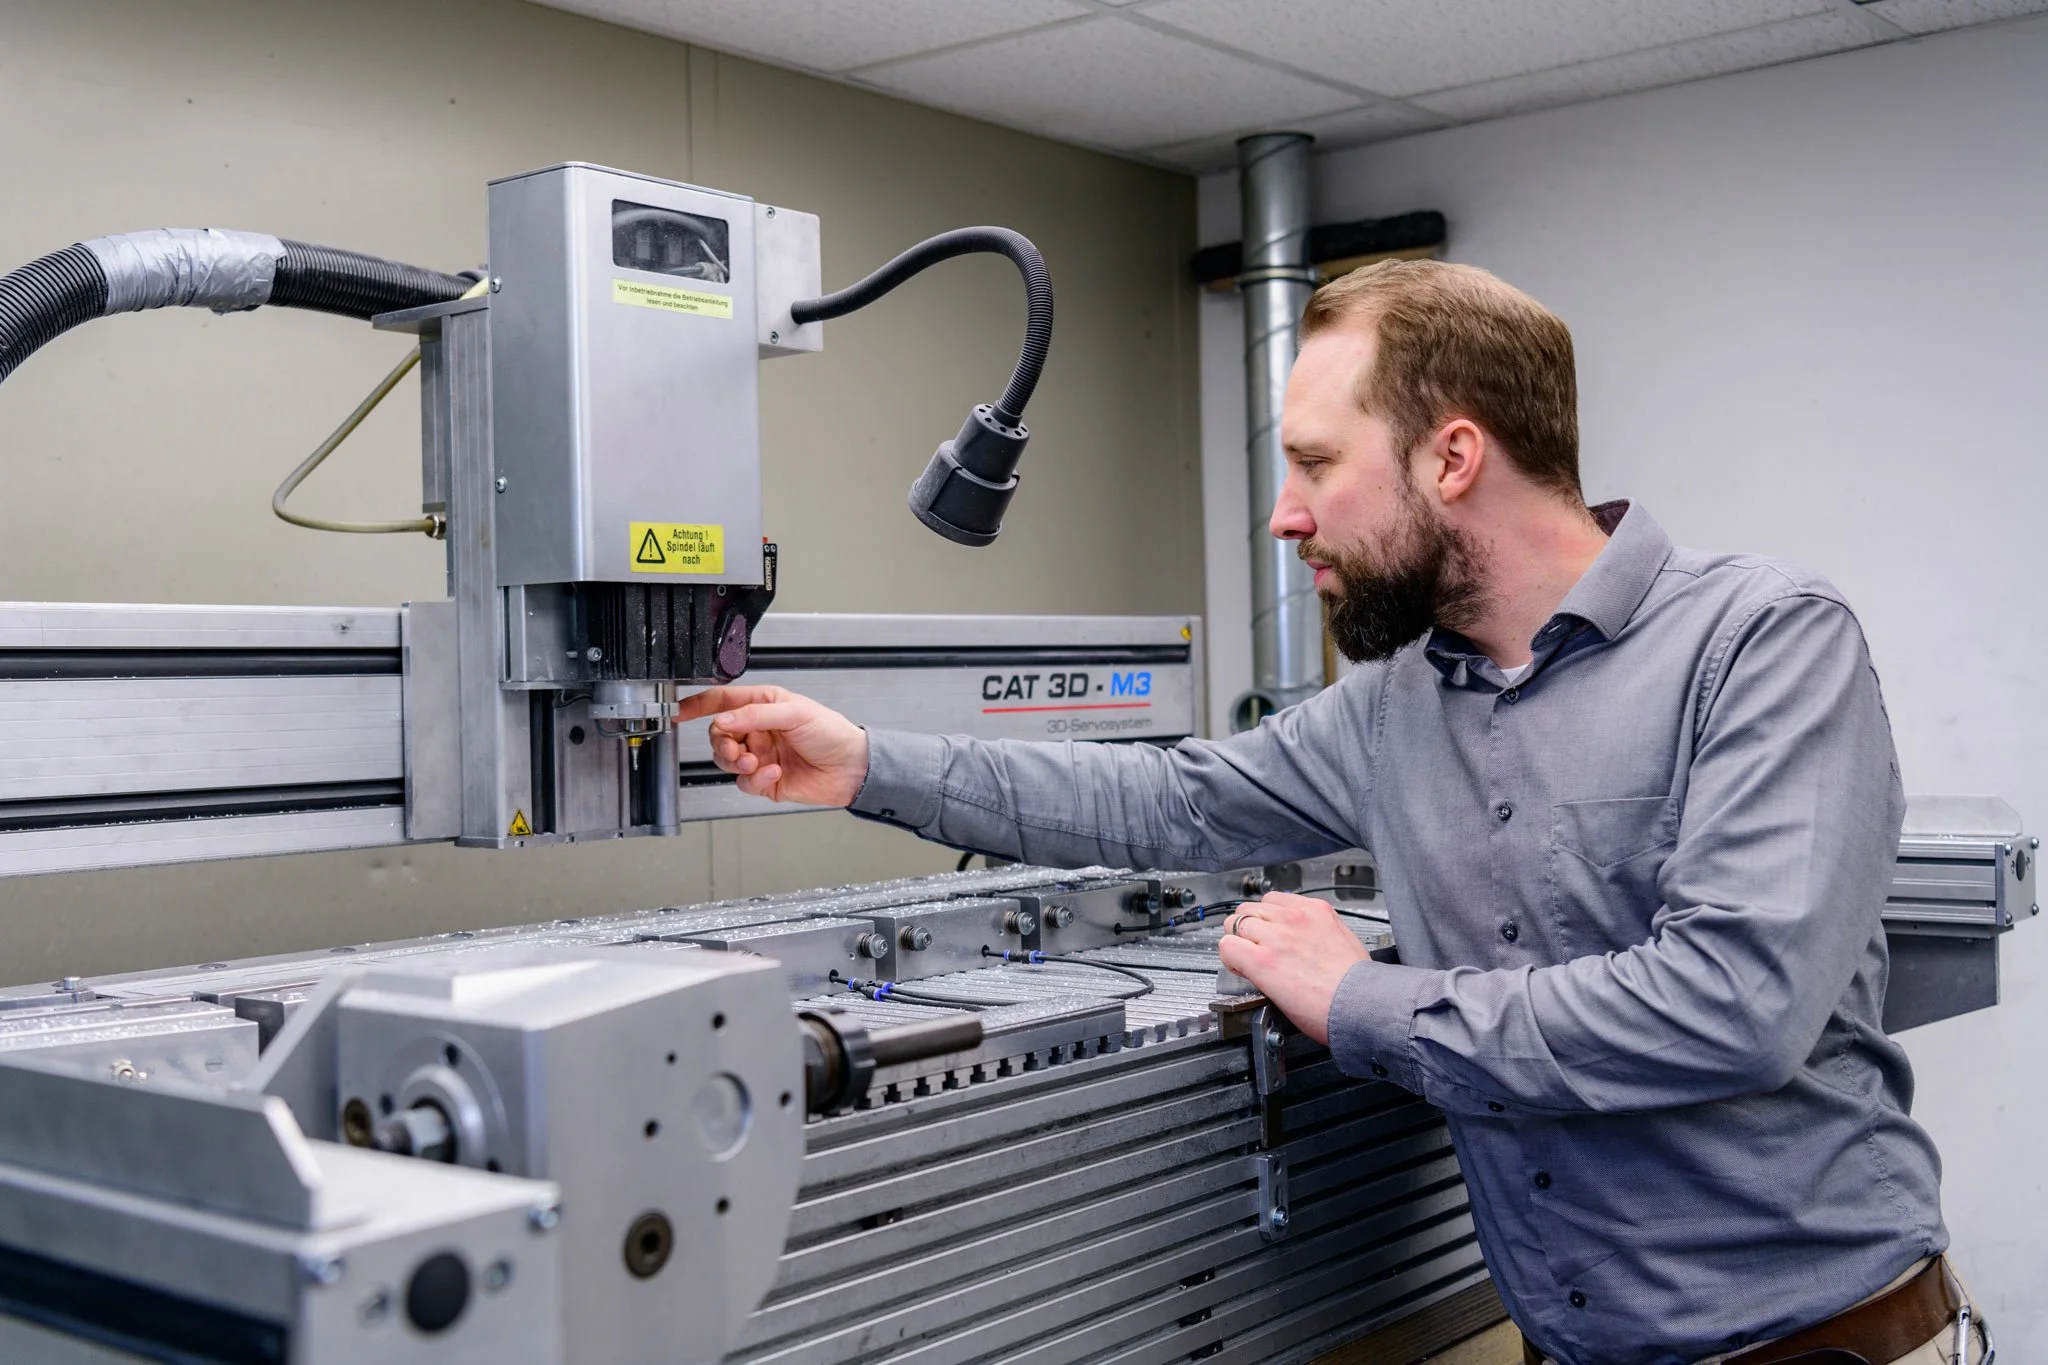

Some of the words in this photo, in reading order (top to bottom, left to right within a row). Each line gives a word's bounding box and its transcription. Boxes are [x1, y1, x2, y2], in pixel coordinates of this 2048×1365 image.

[618, 284, 628, 292] Vor
[629, 286, 672, 299] Inbetriebnahme
[673, 292, 681, 300] die
[682, 294, 728, 308] Betriebsanleitung
[646, 298, 661, 306] lesen
[673, 301, 698, 311] beachten
[673, 529, 703, 542] Achtung
[667, 541, 695, 553] Spindel
[698, 542, 715, 552] läuft
[682, 555, 700, 564] nach
[982, 675, 1040, 700] CAT
[1048, 673, 1089, 698] 3D
[1111, 672, 1152, 696] M3
[1047, 717, 1152, 734] 3D-Servosystem
